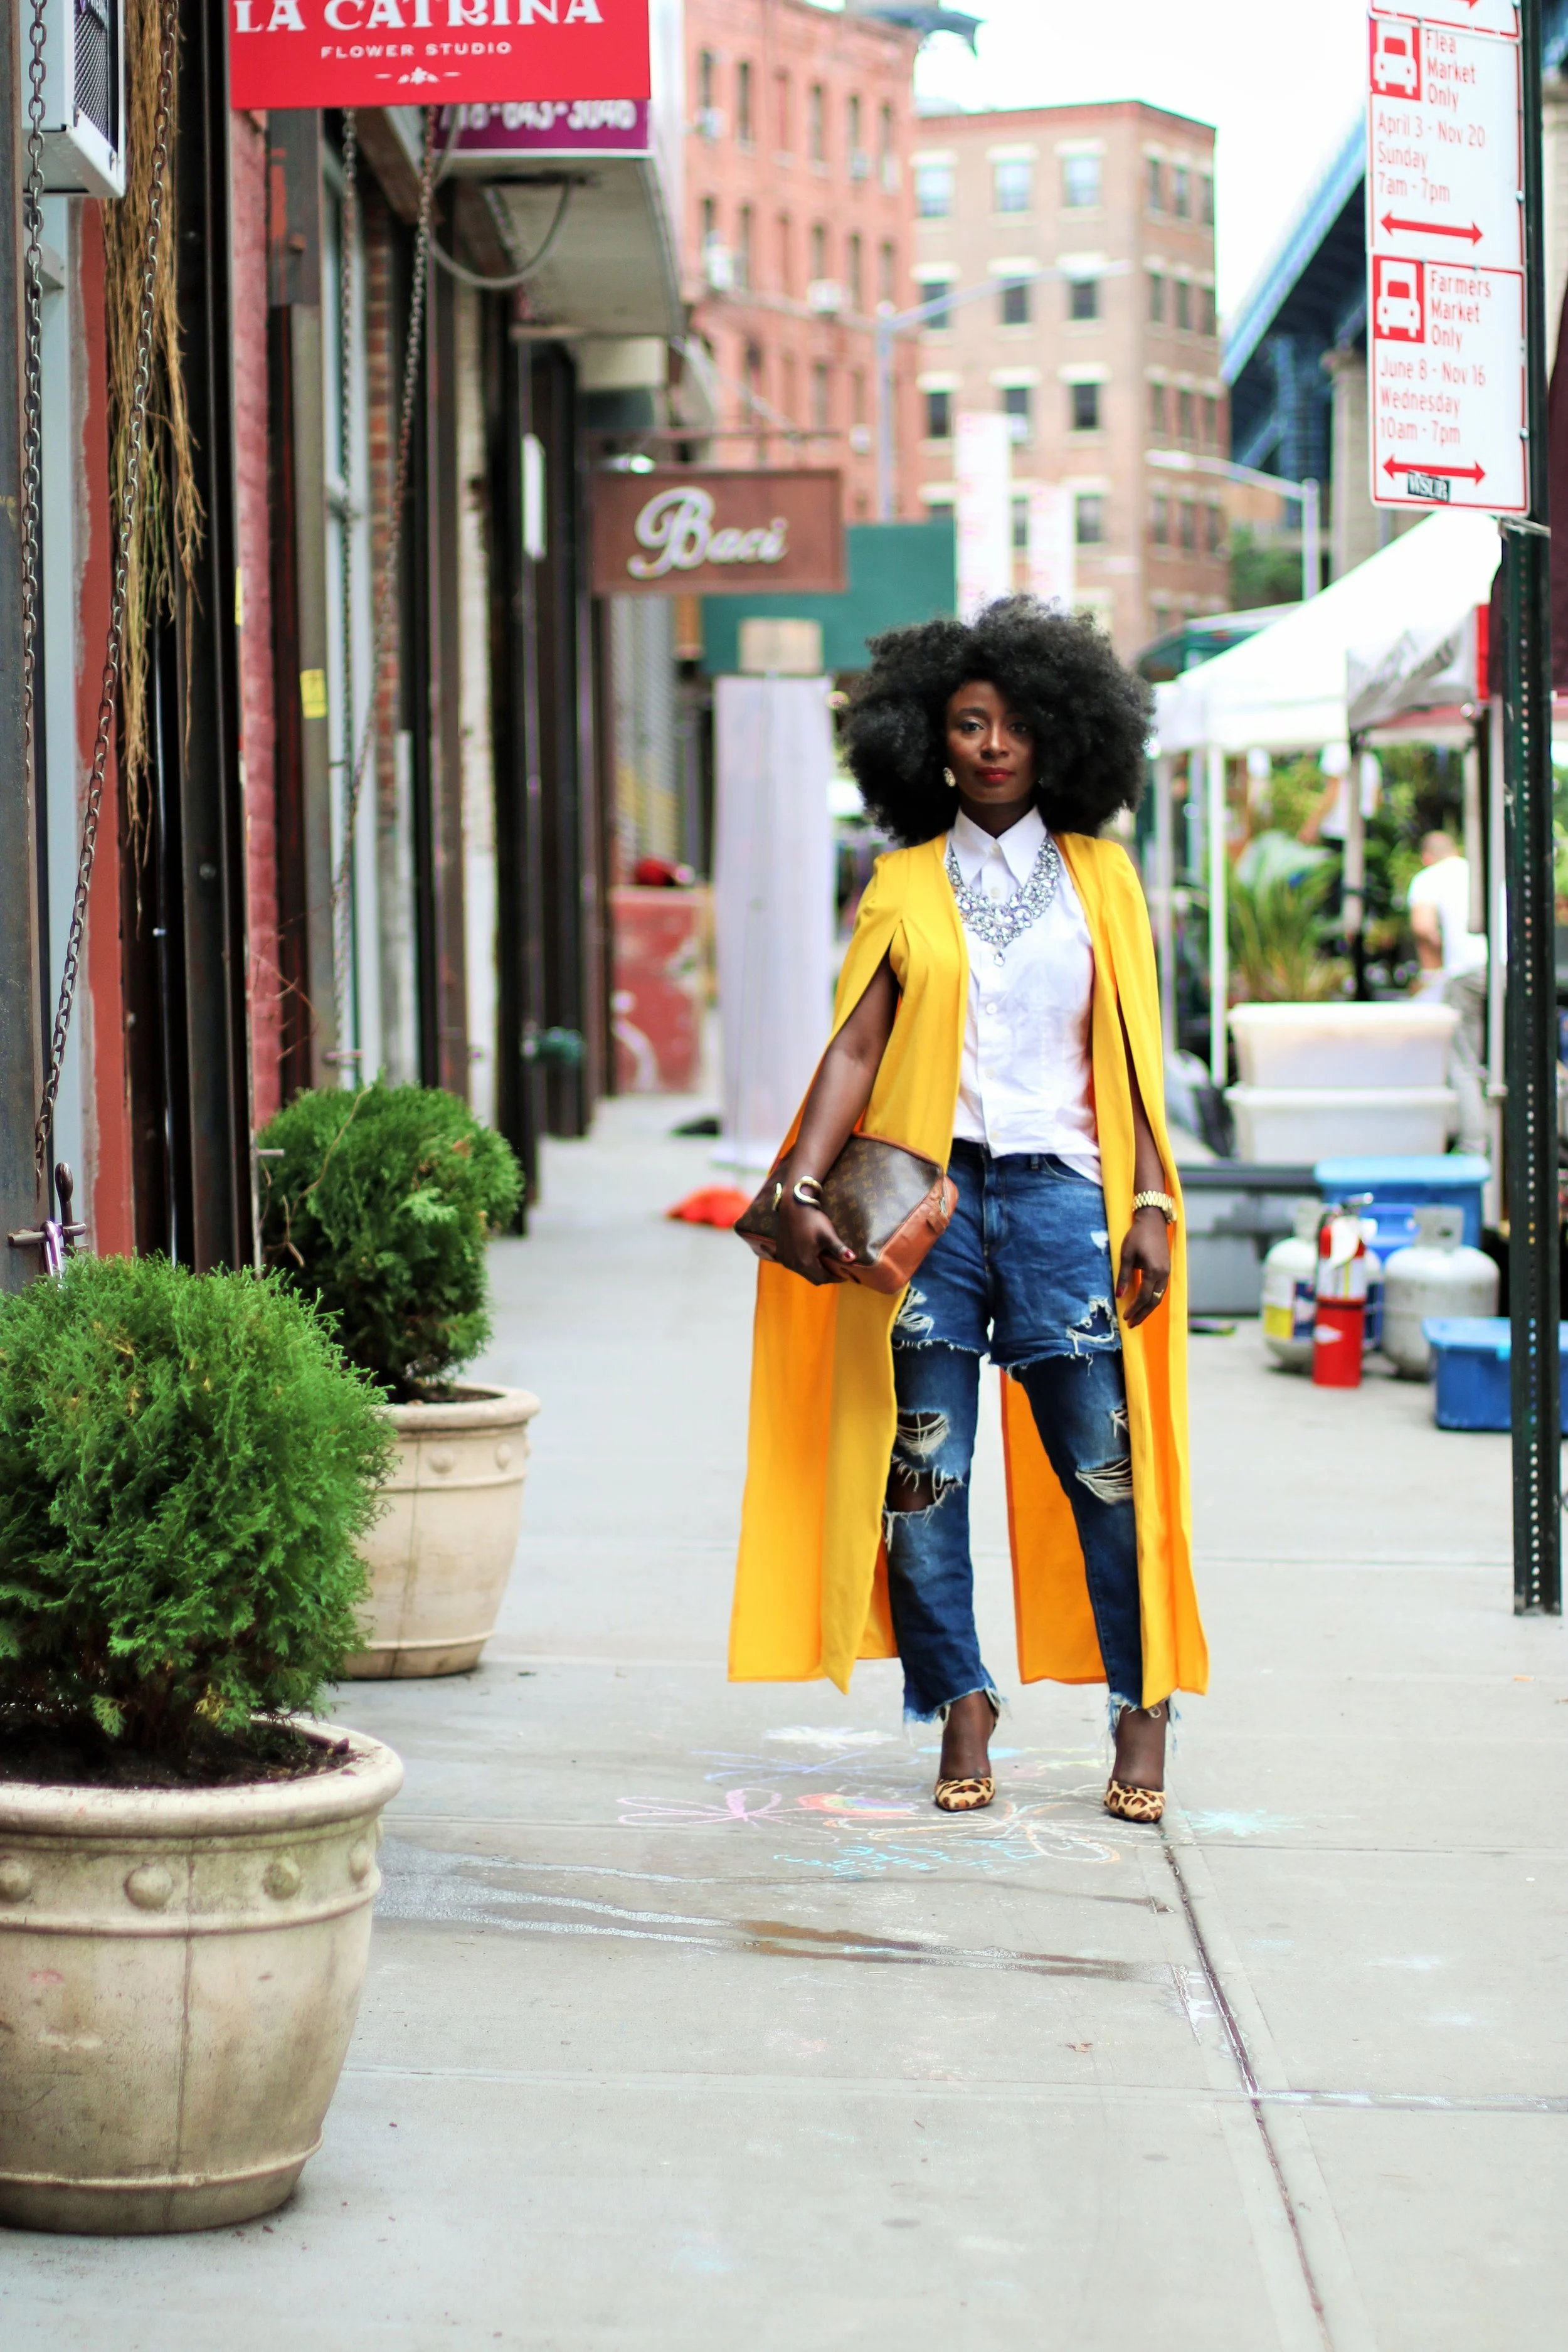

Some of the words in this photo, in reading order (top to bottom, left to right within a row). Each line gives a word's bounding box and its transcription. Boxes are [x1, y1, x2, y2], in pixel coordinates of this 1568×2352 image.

[234, 0, 307, 33] LA
[324, 0, 605, 31] CATRINA
[320, 44, 415, 59] FLOWER
[425, 41, 512, 56] STUDIO
[1425, 29, 1456, 53] Flea
[1426, 56, 1476, 84] Market
[1428, 82, 1459, 113] Only
[1378, 110, 1410, 138] April
[1414, 115, 1423, 138] 3
[1437, 120, 1463, 144] Nov
[1468, 124, 1486, 149] 20
[1378, 141, 1428, 172] Sunday
[1378, 172, 1407, 197] 7am
[1421, 178, 1451, 204] 7pm
[1431, 270, 1492, 299] Farmers
[1431, 296, 1480, 324] Market
[1431, 324, 1463, 354] Only
[1379, 356, 1414, 379] June
[1419, 358, 1428, 380] 8
[1442, 361, 1468, 384] Nov
[1471, 364, 1486, 386] 16
[1380, 386, 1461, 420] Wednesday
[1380, 416, 1418, 440] 10am
[1431, 420, 1461, 447] 7pm
[627, 485, 790, 581] Baci
